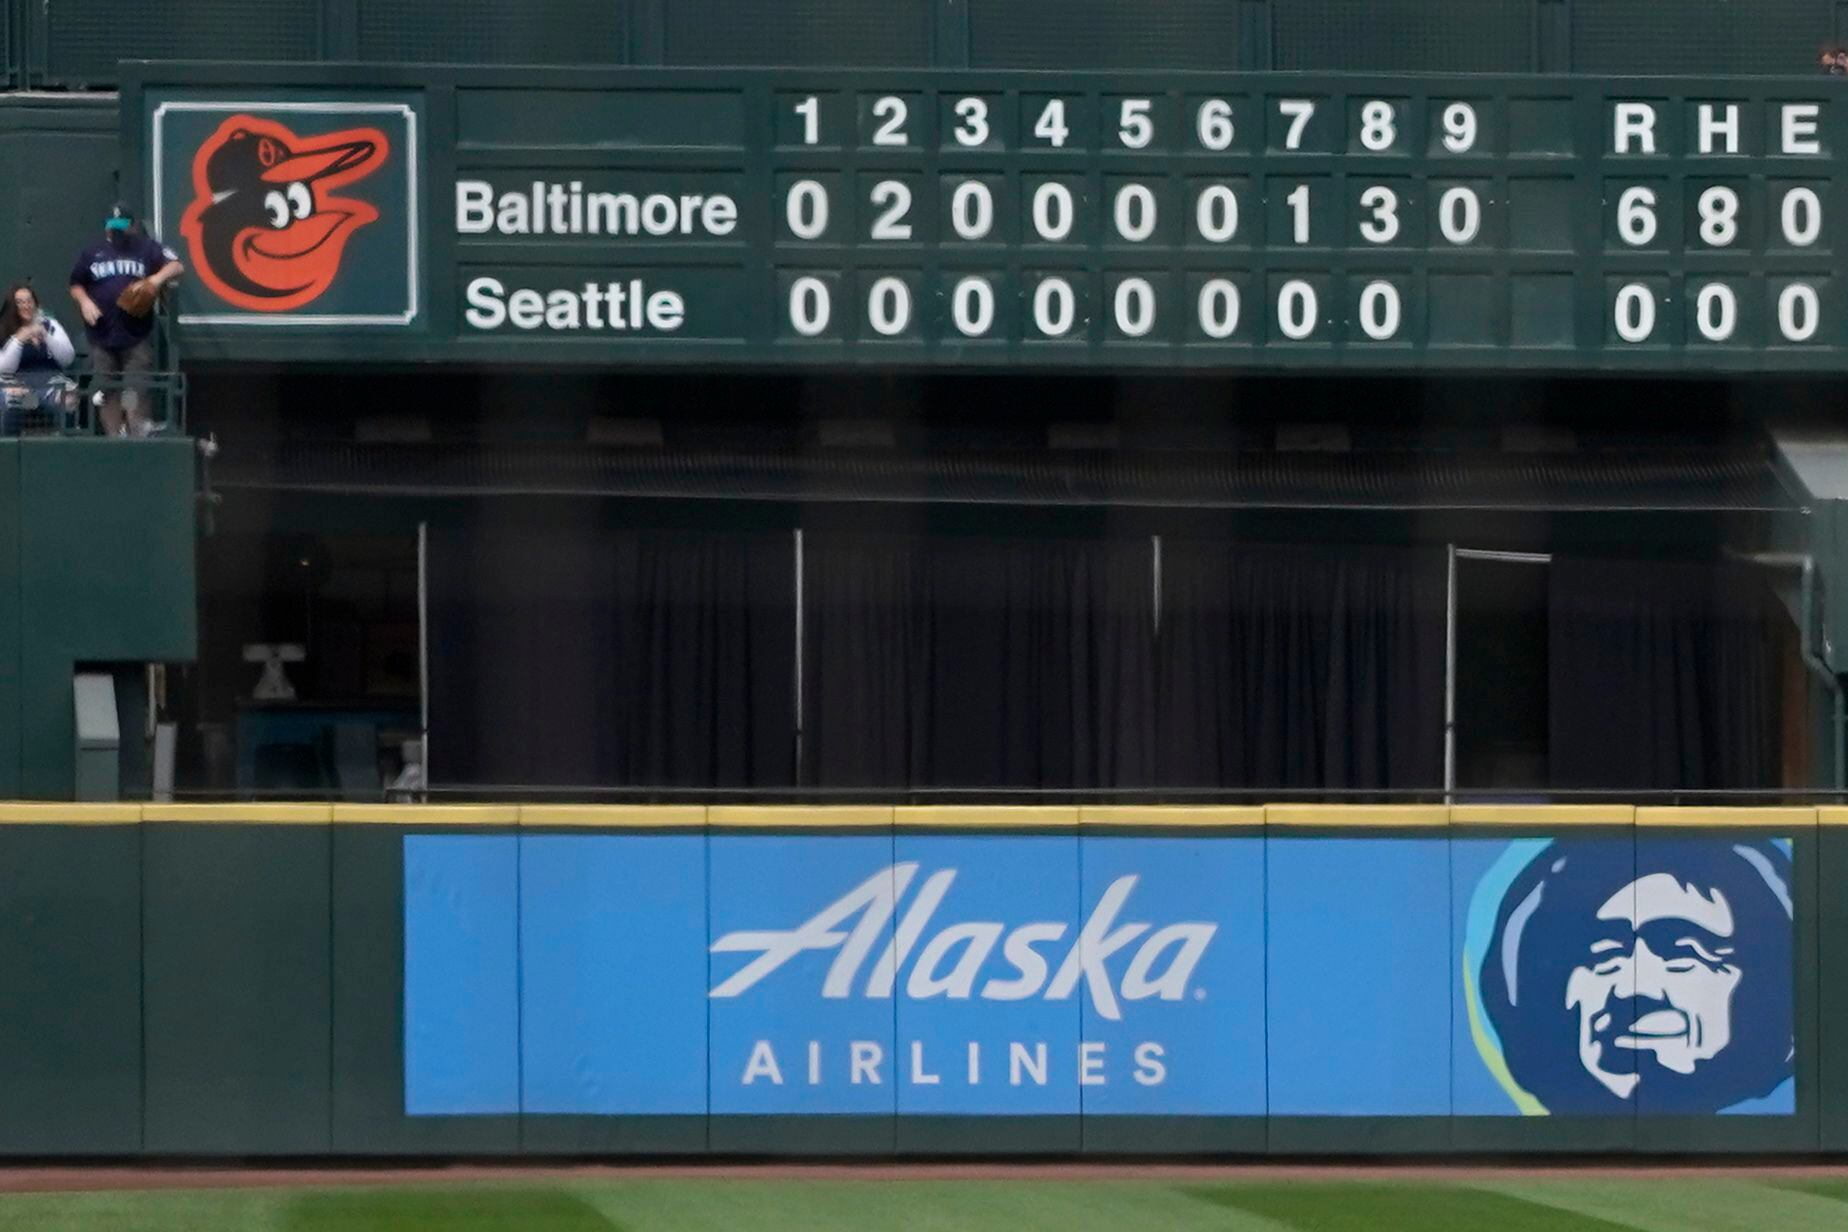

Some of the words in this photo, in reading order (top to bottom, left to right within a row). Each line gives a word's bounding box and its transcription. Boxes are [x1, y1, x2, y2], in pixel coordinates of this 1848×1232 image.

[795, 96, 819, 145] 1
[872, 96, 908, 146] 2
[954, 97, 989, 147] 3
[1034, 99, 1069, 147] 4
[1118, 99, 1153, 149] 5
[1197, 99, 1234, 151] 6
[1279, 100, 1315, 149] 7
[1360, 100, 1396, 151] 8
[1442, 102, 1477, 154] 9
[1614, 102, 1656, 154] R
[1698, 104, 1739, 154] H
[1781, 104, 1821, 154] E
[455, 179, 739, 236] Baltimore
[786, 179, 829, 240] 0
[870, 180, 912, 240] 2
[951, 180, 993, 240] 0
[1032, 182, 1074, 241] 0
[1114, 183, 1157, 242] 0
[1196, 184, 1239, 243] 0
[1287, 185, 1309, 244] 1
[1359, 185, 1400, 244] 3
[1438, 186, 1481, 245] 0
[1617, 186, 1657, 246] 6
[1697, 186, 1739, 247] 8
[1781, 187, 1822, 247] 0
[464, 276, 686, 331] Seattle
[789, 276, 831, 336] 0
[868, 276, 911, 336] 0
[952, 276, 995, 337] 0
[1033, 277, 1075, 336] 0
[1114, 277, 1156, 337] 0
[1198, 278, 1240, 338] 0
[1277, 279, 1318, 339] 0
[1359, 279, 1401, 340] 0
[1614, 283, 1656, 343] 0
[1696, 282, 1737, 341] 0
[1778, 282, 1820, 342] 0
[708, 860, 1218, 1021] Alaska
[741, 1040, 1168, 1086] AIRLINES
